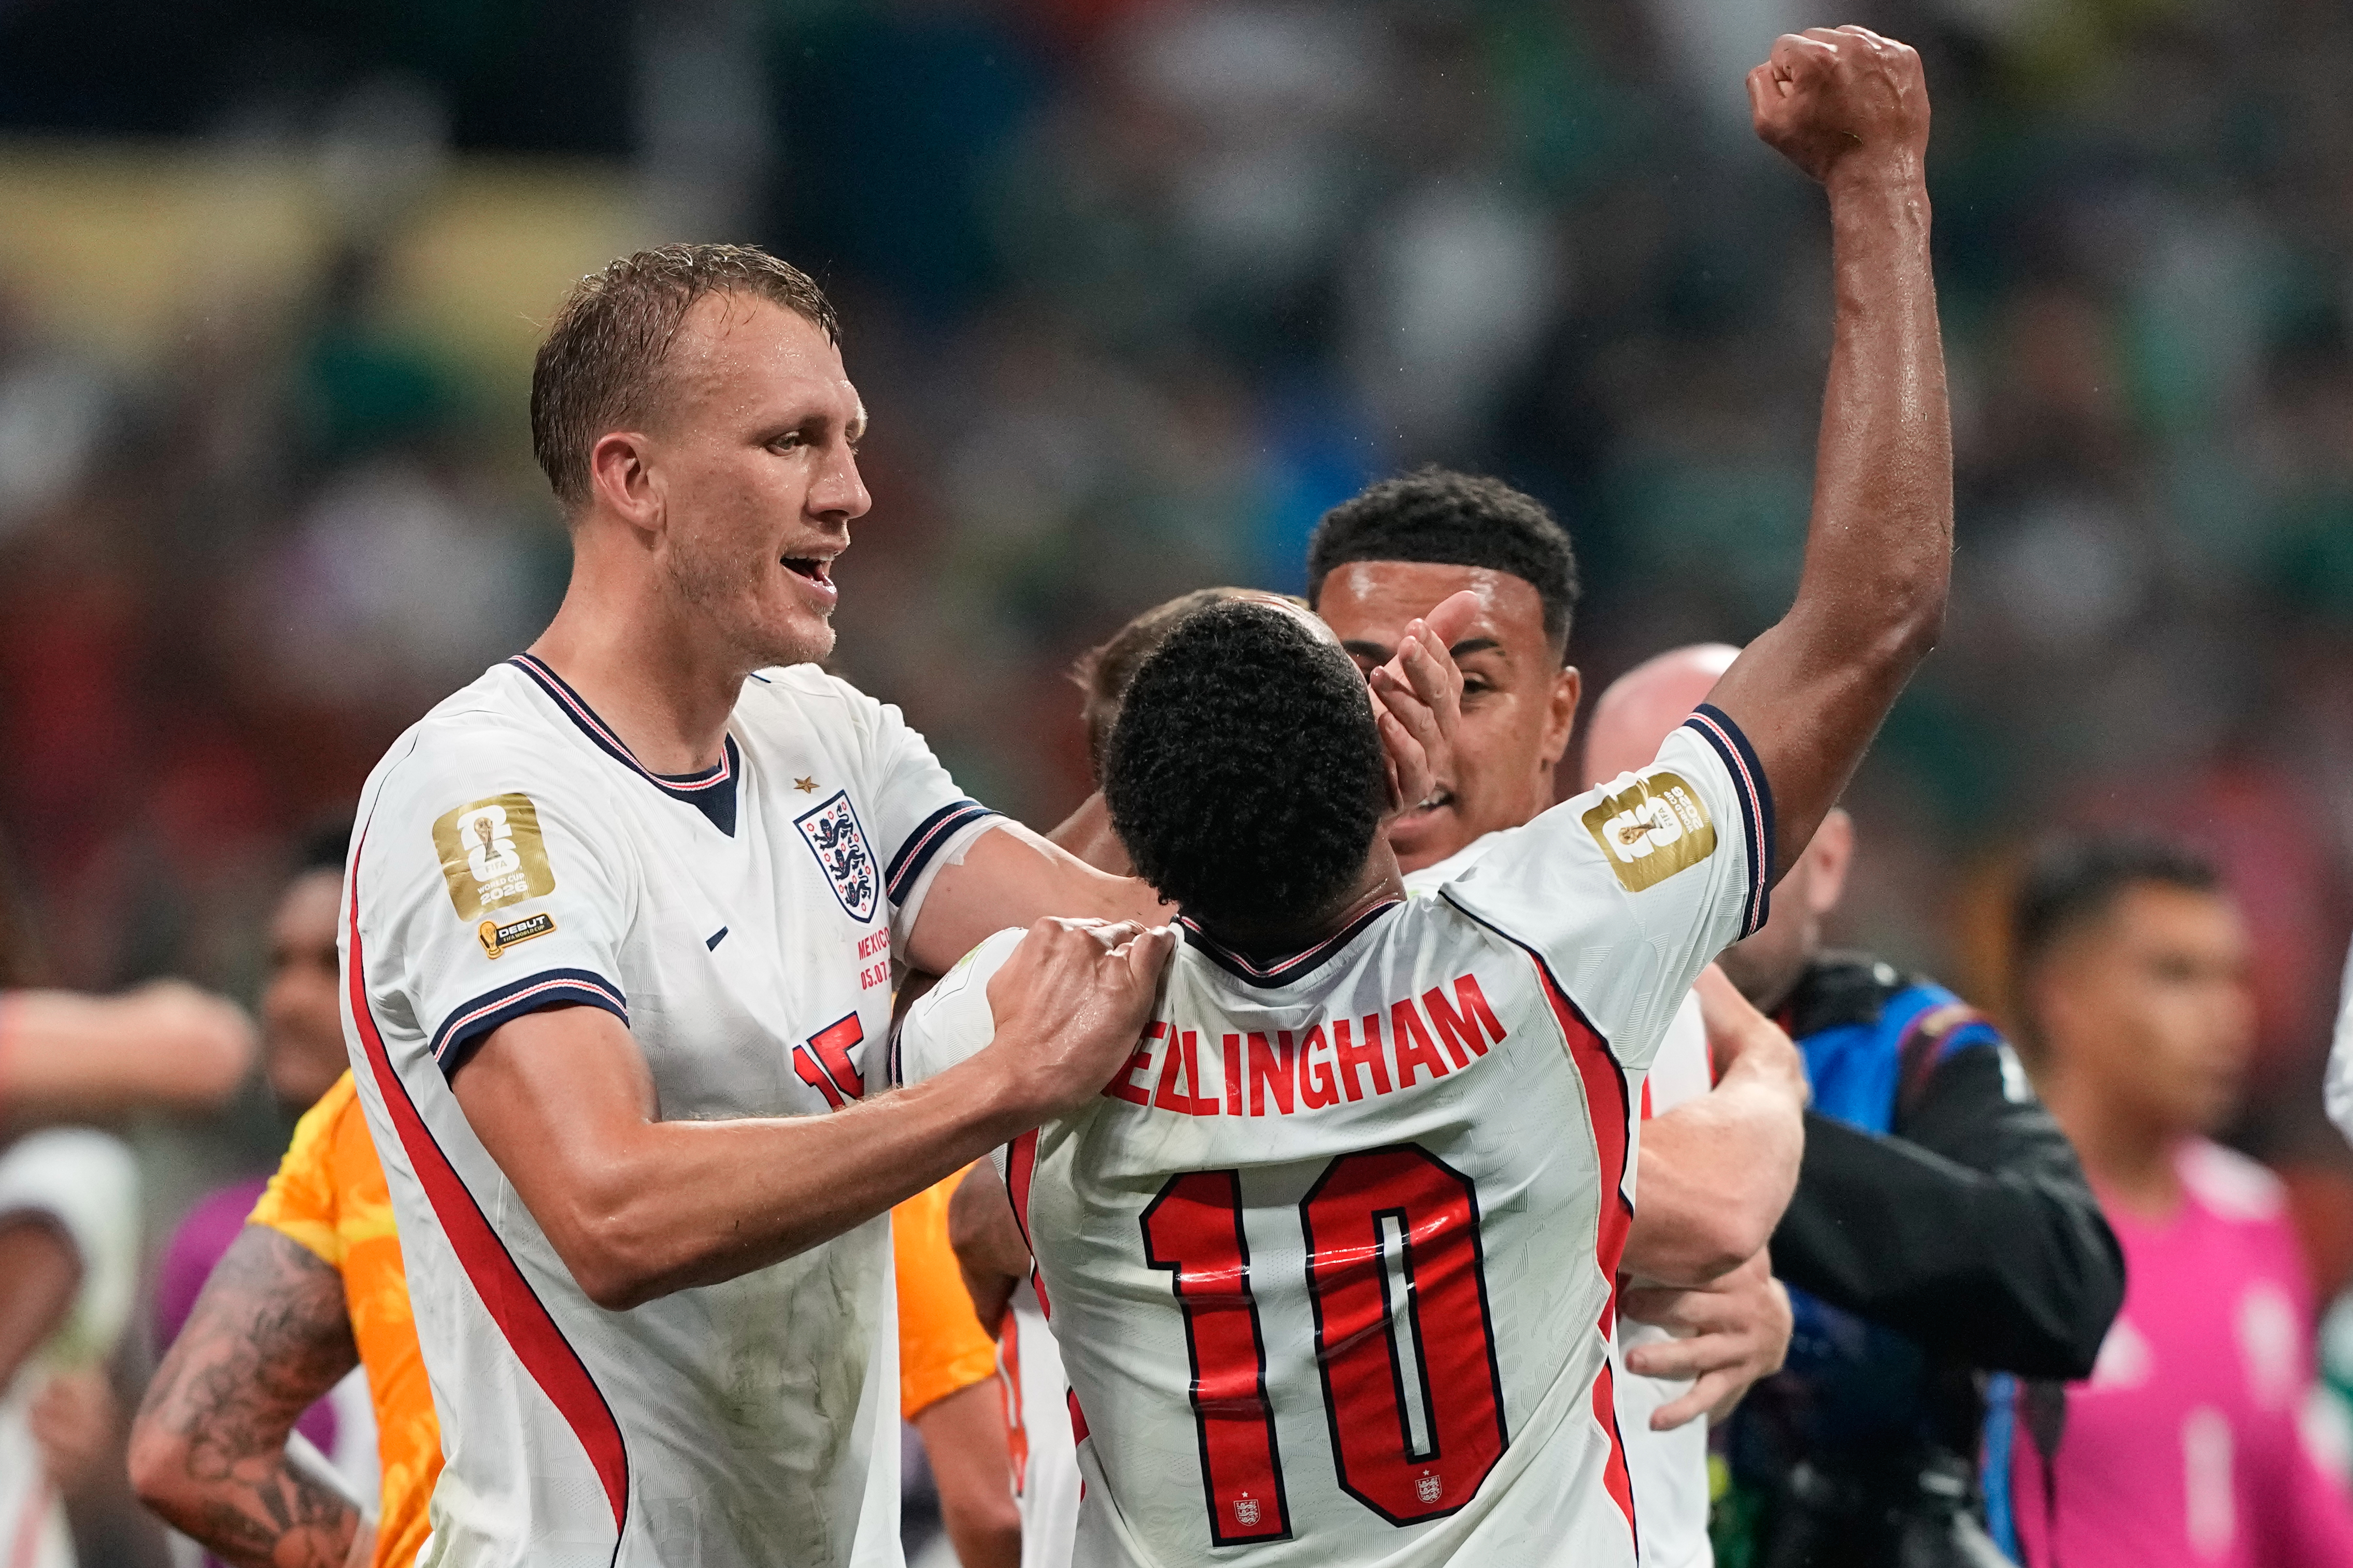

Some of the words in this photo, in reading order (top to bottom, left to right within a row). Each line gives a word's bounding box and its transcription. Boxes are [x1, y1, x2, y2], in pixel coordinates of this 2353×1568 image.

[1663, 792, 1677, 804] CUP
[1671, 786, 1704, 830] 2026
[1658, 807, 1673, 826] FIFA
[1675, 804, 1694, 833] WORLD
[485, 860, 507, 873] FIFA
[477, 877, 506, 894] WORLD
[508, 873, 525, 882] CUP
[480, 881, 528, 905] 2026
[498, 916, 545, 938] DEBUT
[858, 926, 890, 960] MEXICO
[1100, 973, 1507, 1117] ELLINGHAM
[1138, 1142, 1510, 1547] 10
